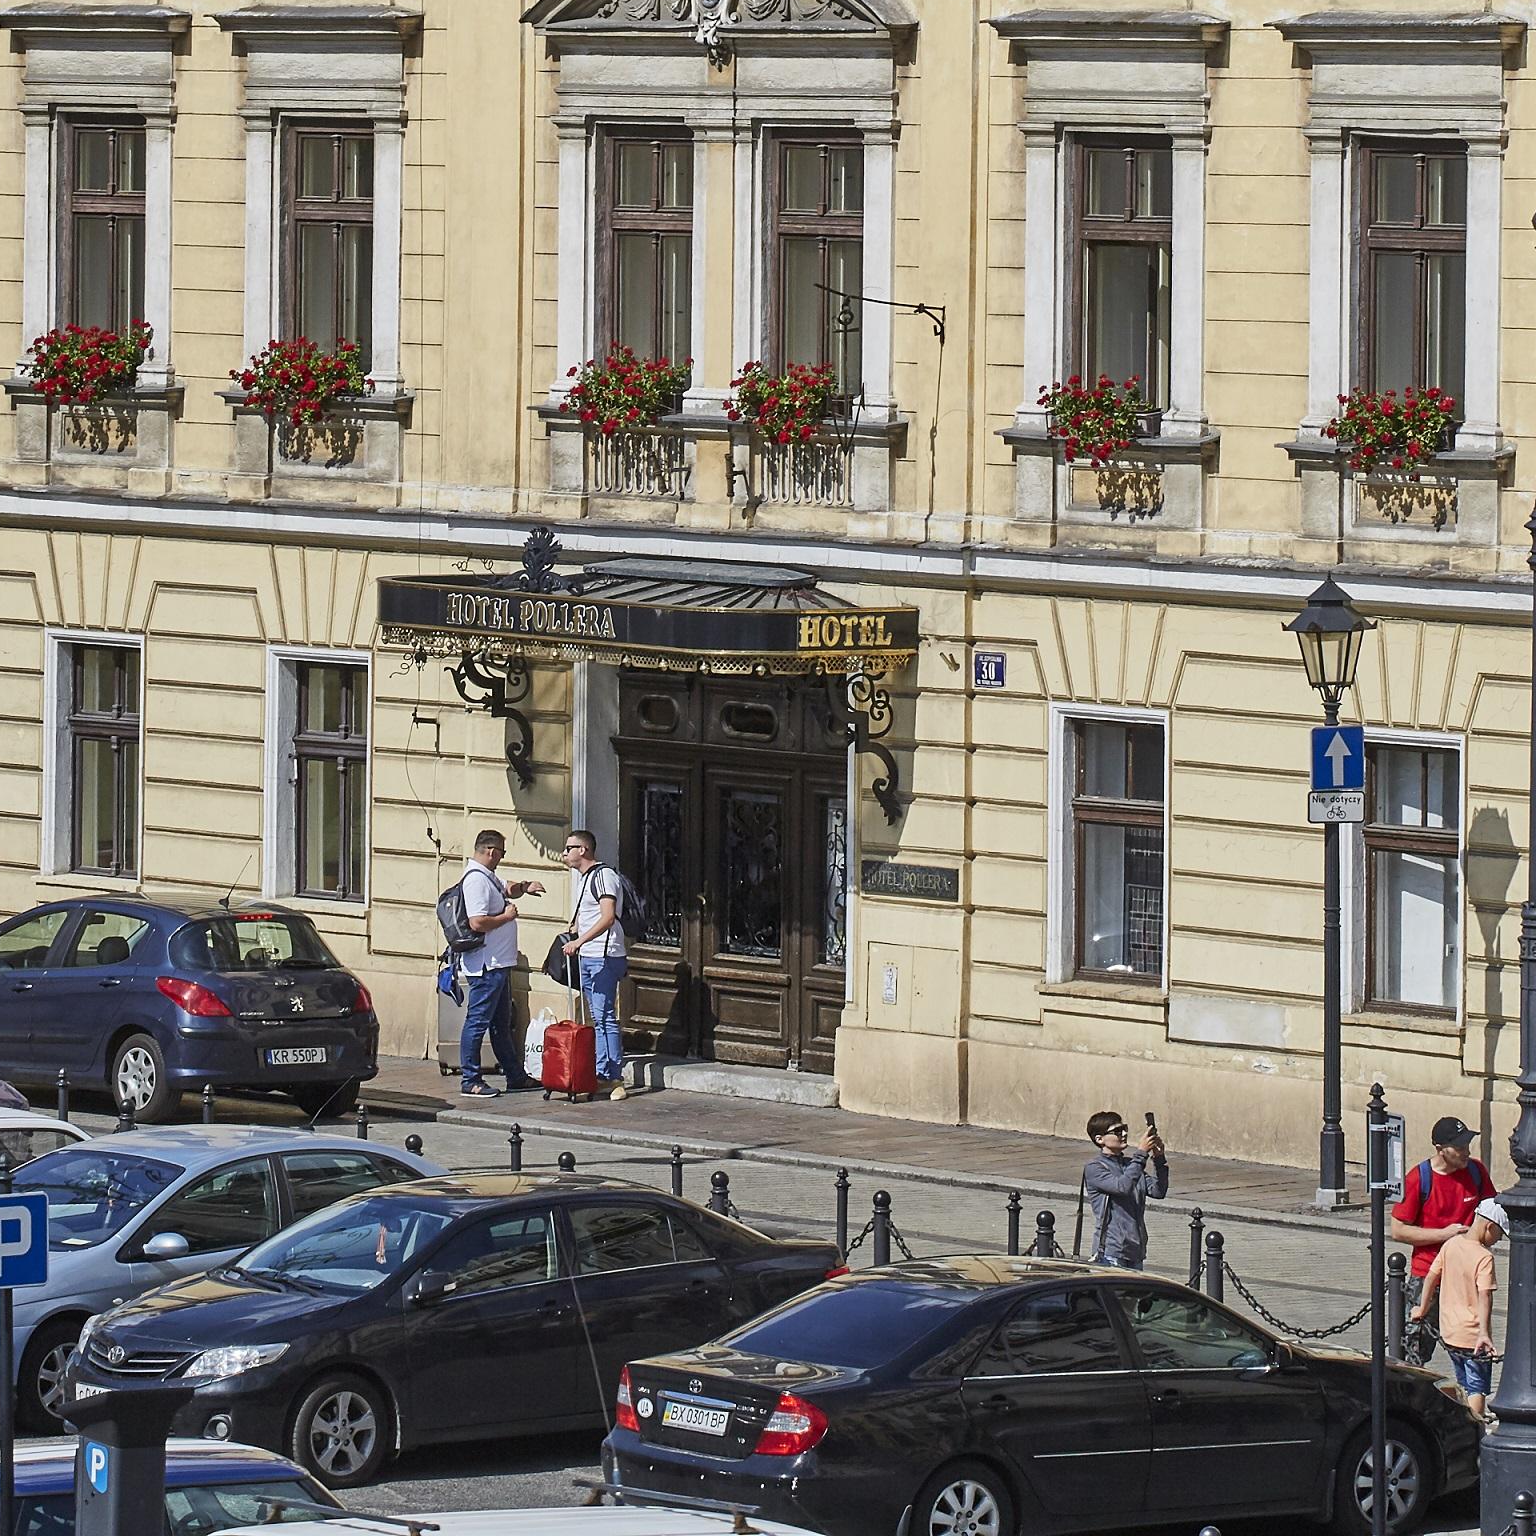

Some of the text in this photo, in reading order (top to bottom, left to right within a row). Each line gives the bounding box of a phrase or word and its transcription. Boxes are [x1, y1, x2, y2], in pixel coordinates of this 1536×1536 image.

[446, 592, 616, 638] HOTEL POLLERA
[798, 615, 892, 648] HOTEL
[982, 662, 995, 680] 30
[1312, 796, 1360, 804] Nie dotyczy
[274, 1049, 324, 1063] KR 550PJ
[640, 1403, 648, 1413] UA
[671, 1406, 686, 1421] BX
[92, 1448, 105, 1483] P
